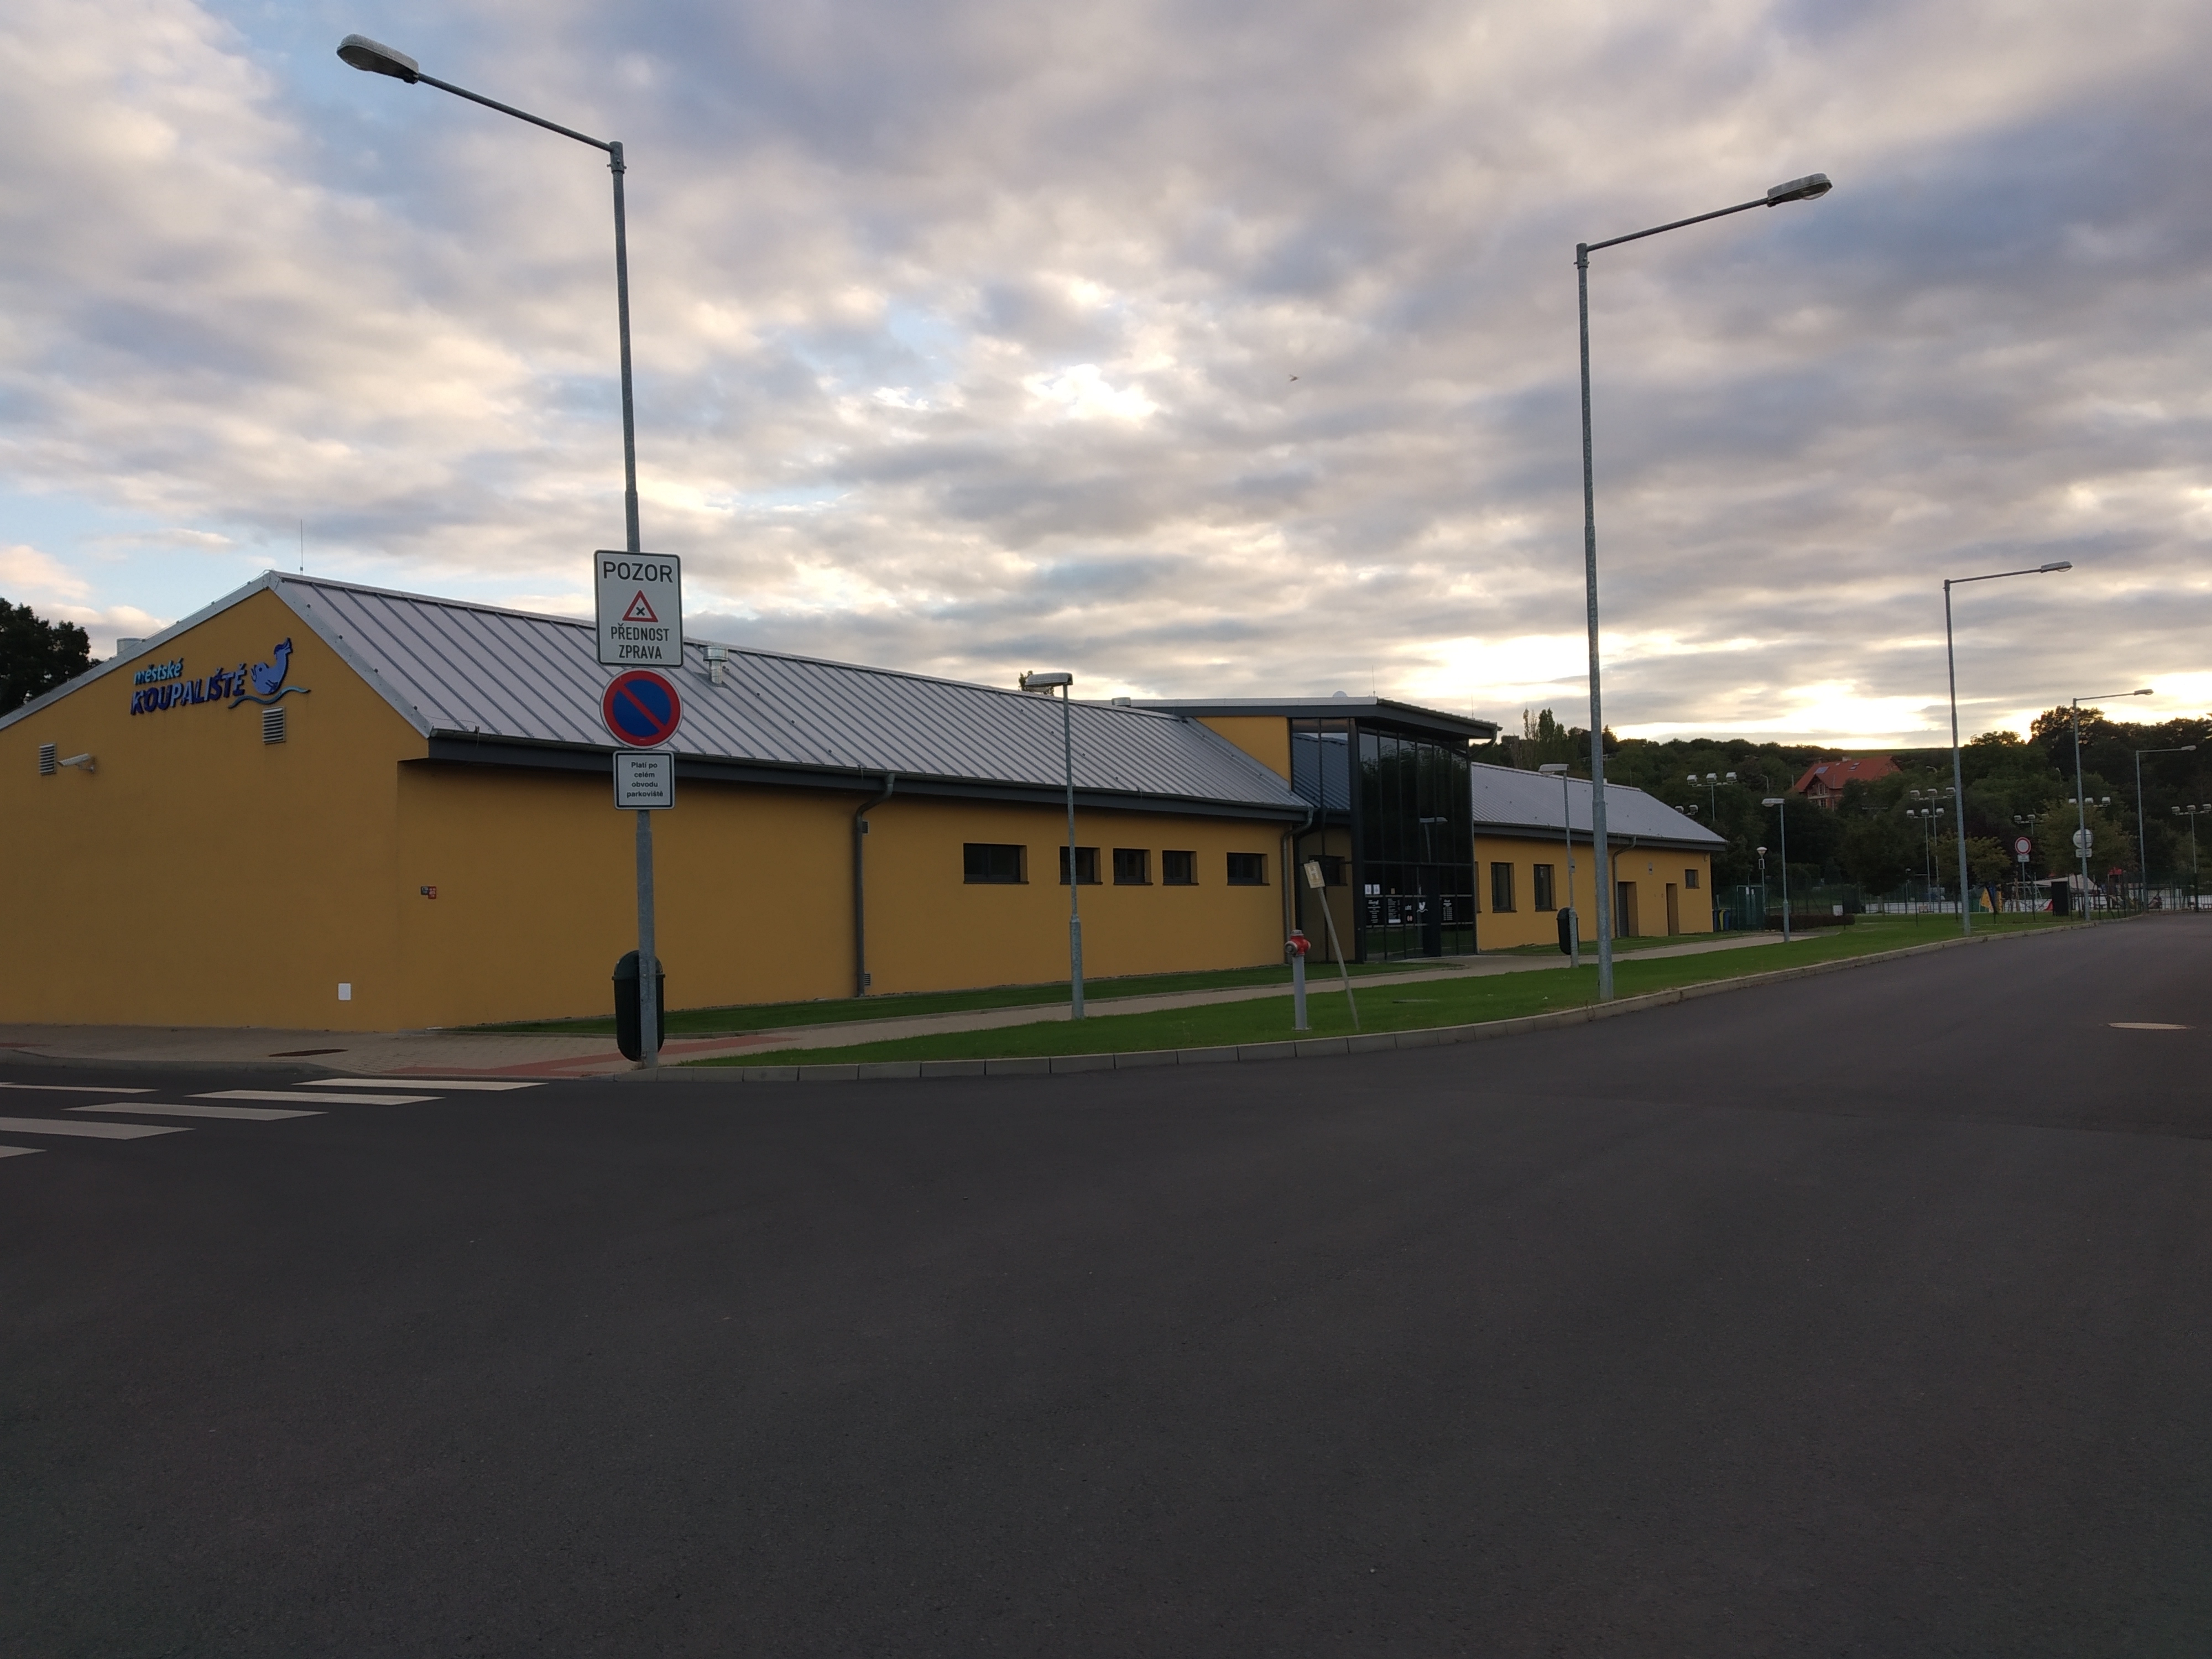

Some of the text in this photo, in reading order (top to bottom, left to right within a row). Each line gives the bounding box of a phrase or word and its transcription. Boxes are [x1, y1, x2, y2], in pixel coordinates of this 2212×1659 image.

[603, 561, 673, 583] POZOR
[611, 622, 670, 641] PŘEDNOST
[619, 644, 662, 660] ZPRAVA
[134, 657, 184, 685] městské
[131, 664, 247, 716] KOUPALIŠTĚ
